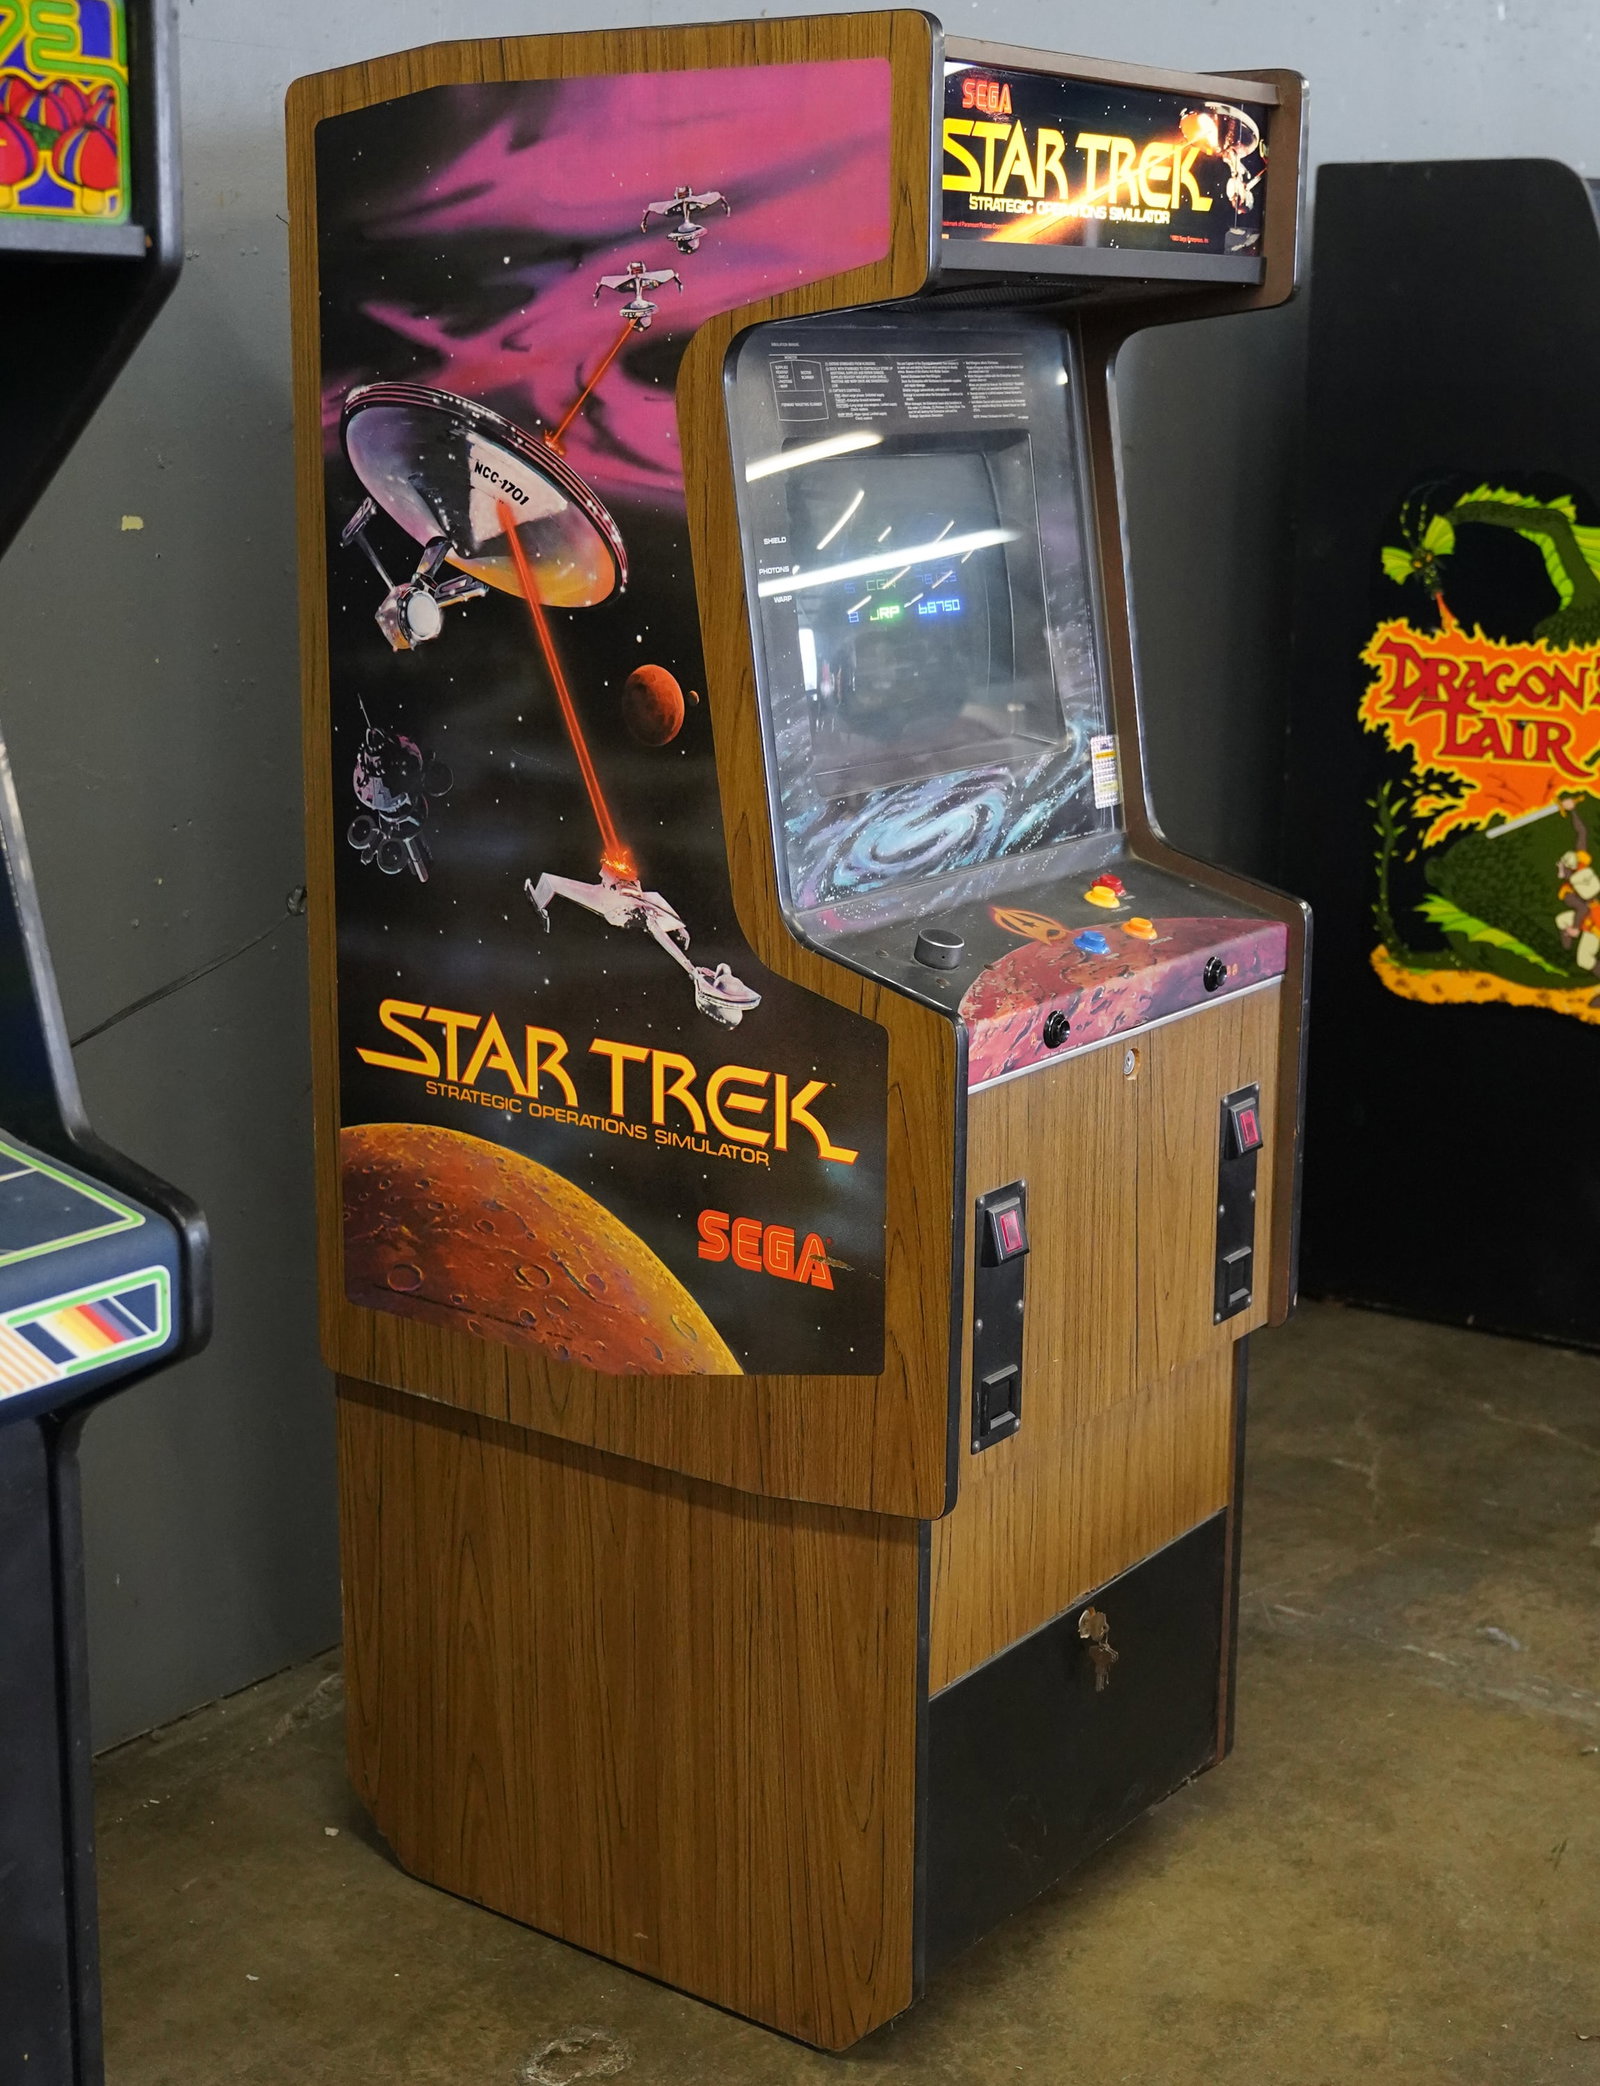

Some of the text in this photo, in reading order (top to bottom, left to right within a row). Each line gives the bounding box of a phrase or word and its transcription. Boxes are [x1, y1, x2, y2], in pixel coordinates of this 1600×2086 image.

[962, 78, 1012, 114] SEGA
[942, 117, 1213, 211] STAR TREK
[968, 194, 1171, 224] STRATEGIC OPERATIONS SIMULATOR
[474, 461, 530, 505] NCC-1701
[763, 536, 787, 545] SHIELD
[758, 566, 790, 576] PHOTONS
[773, 595, 793, 604] WARP
[869, 605, 900, 621] JRP
[918, 599, 961, 615] 68750
[1408, 698, 1595, 777] LAIR
[356, 998, 859, 1166] STAR TREK
[425, 1080, 770, 1167] STRATEGIC OPERATIONS SIMULATOR
[697, 1208, 835, 1291] SEGA
